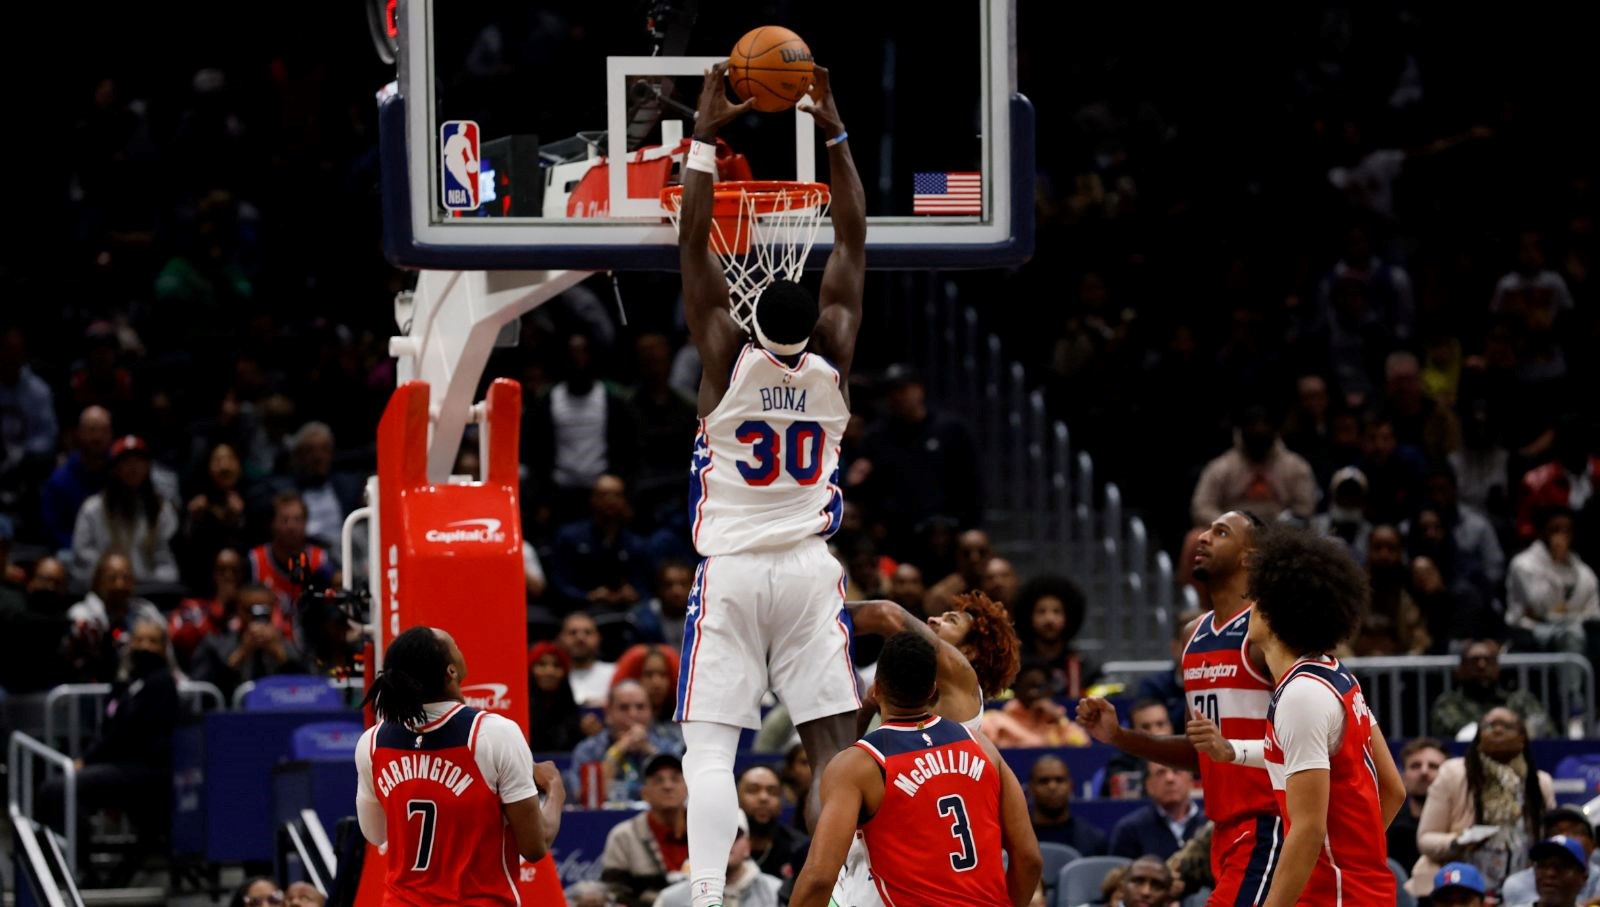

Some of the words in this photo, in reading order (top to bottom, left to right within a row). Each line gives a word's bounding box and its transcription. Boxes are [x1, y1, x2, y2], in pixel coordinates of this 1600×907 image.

[448, 188, 467, 204] NBA
[760, 386, 807, 412] BONA
[735, 420, 826, 486] 30
[387, 544, 399, 637] ards
[377, 754, 474, 797] CARRINGTON
[893, 749, 985, 797] McCOLLUM
[406, 799, 437, 871] 7
[936, 793, 978, 872] 3
